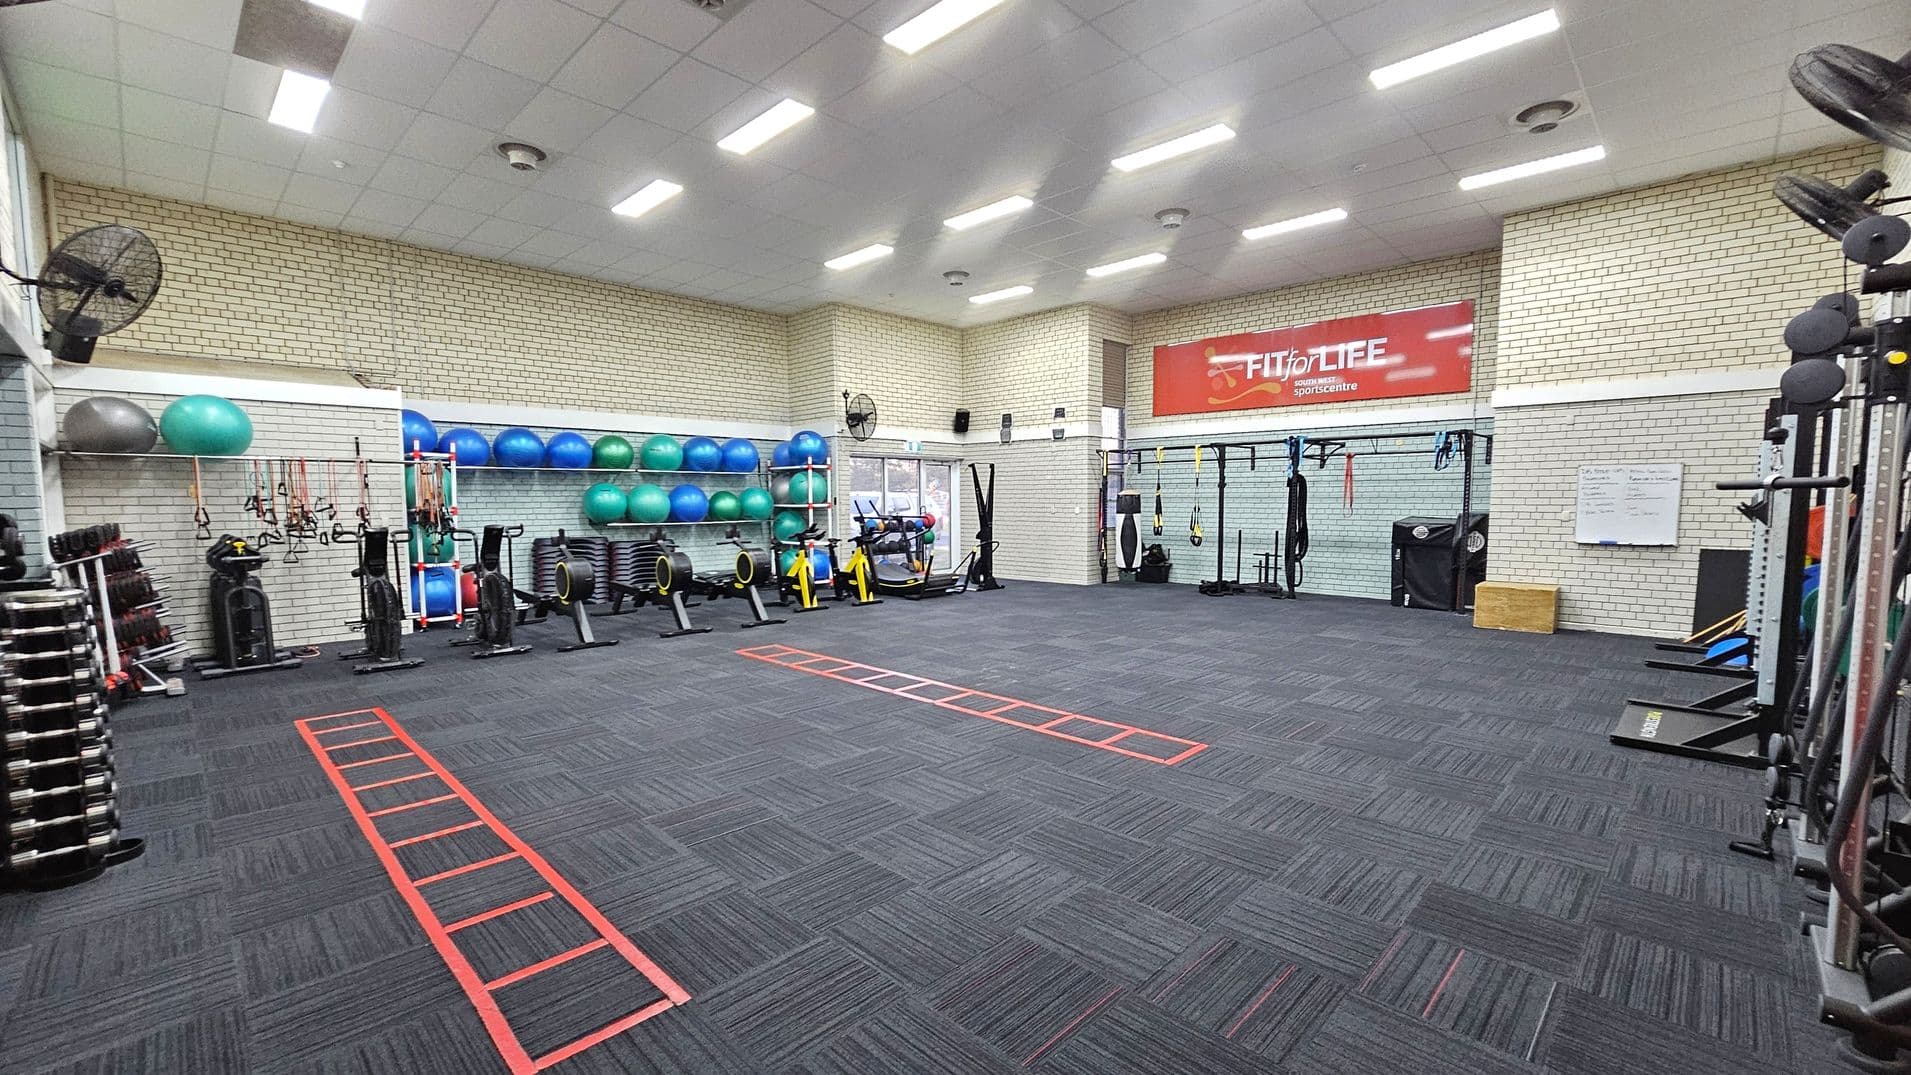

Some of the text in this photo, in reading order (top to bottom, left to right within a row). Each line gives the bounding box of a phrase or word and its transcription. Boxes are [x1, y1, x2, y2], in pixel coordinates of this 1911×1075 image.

[1294, 376, 1337, 387] SOUTH WEST
[1293, 382, 1358, 398] sportscentre
